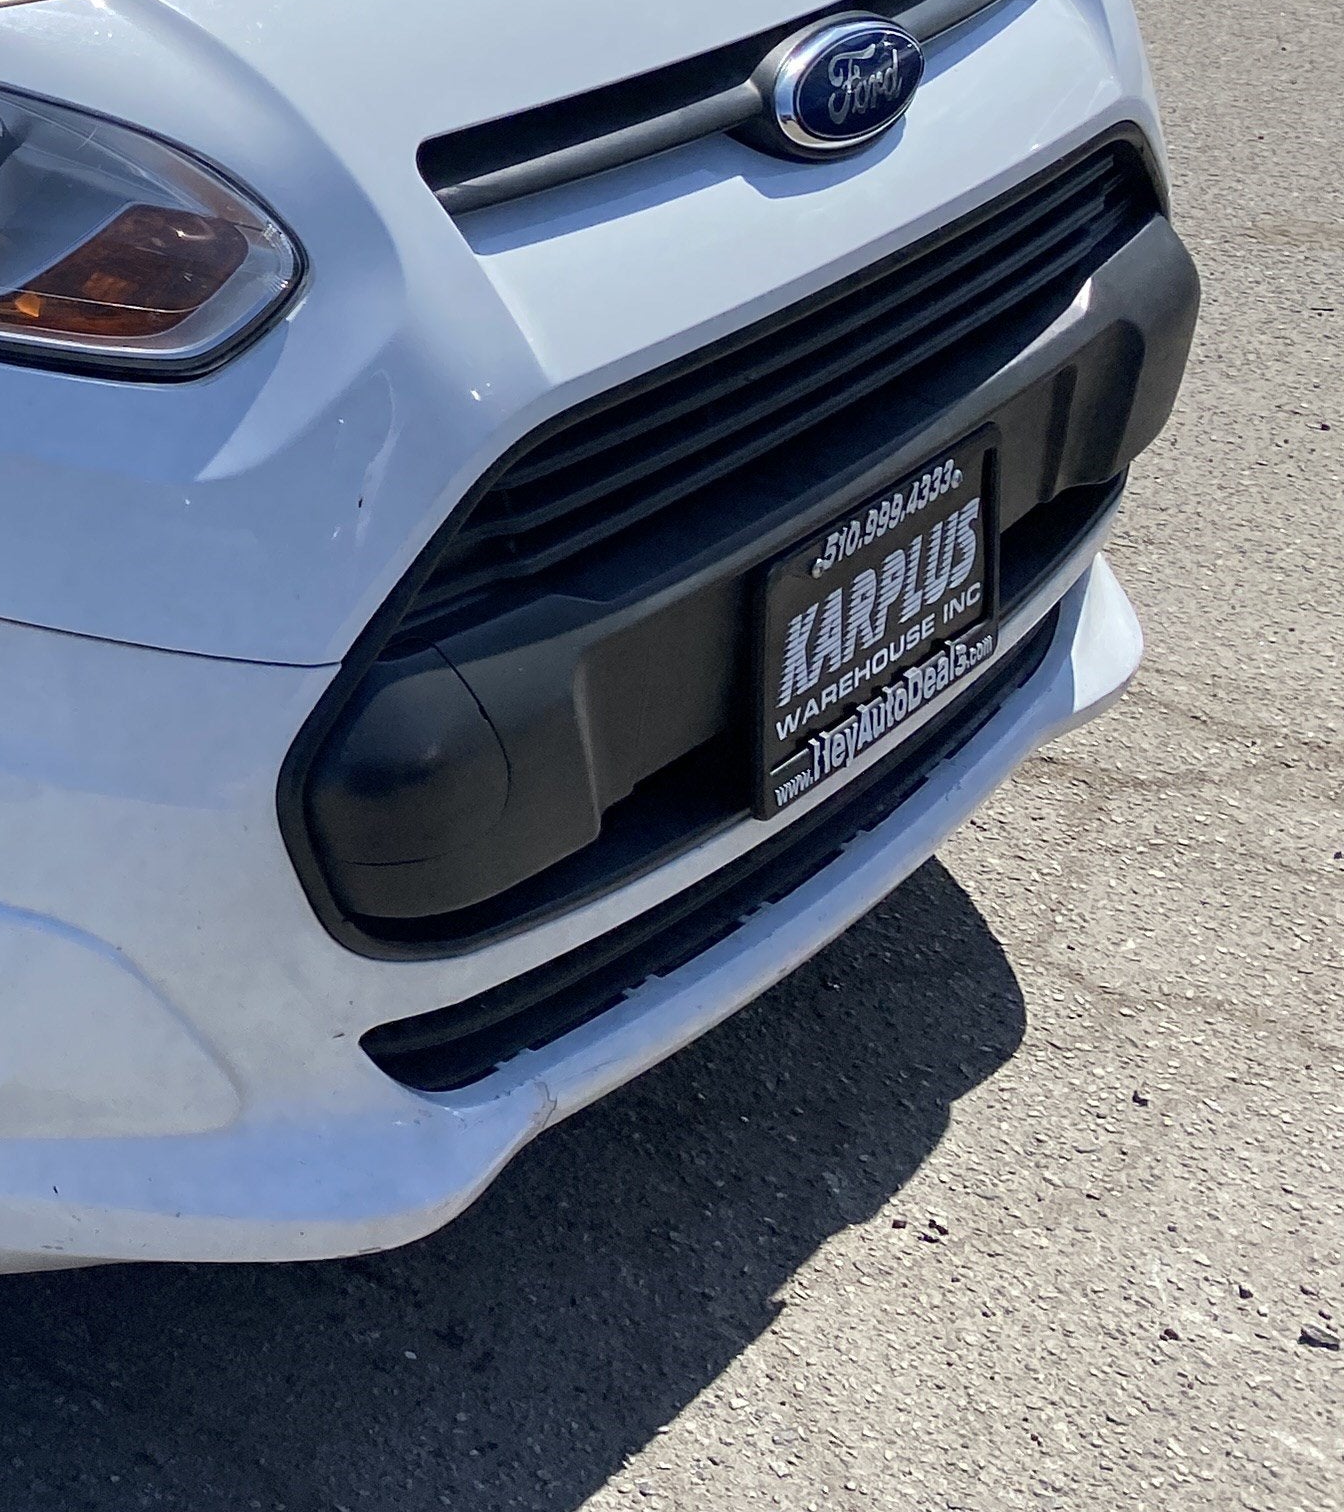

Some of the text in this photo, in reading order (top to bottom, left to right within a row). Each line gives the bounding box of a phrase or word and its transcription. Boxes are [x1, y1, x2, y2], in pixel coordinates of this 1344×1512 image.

[828, 43, 903, 125] Ford
[821, 458, 955, 571] 510.999.4333
[775, 496, 981, 708] KARPLUS
[775, 581, 982, 741] WAREHOUSE INC
